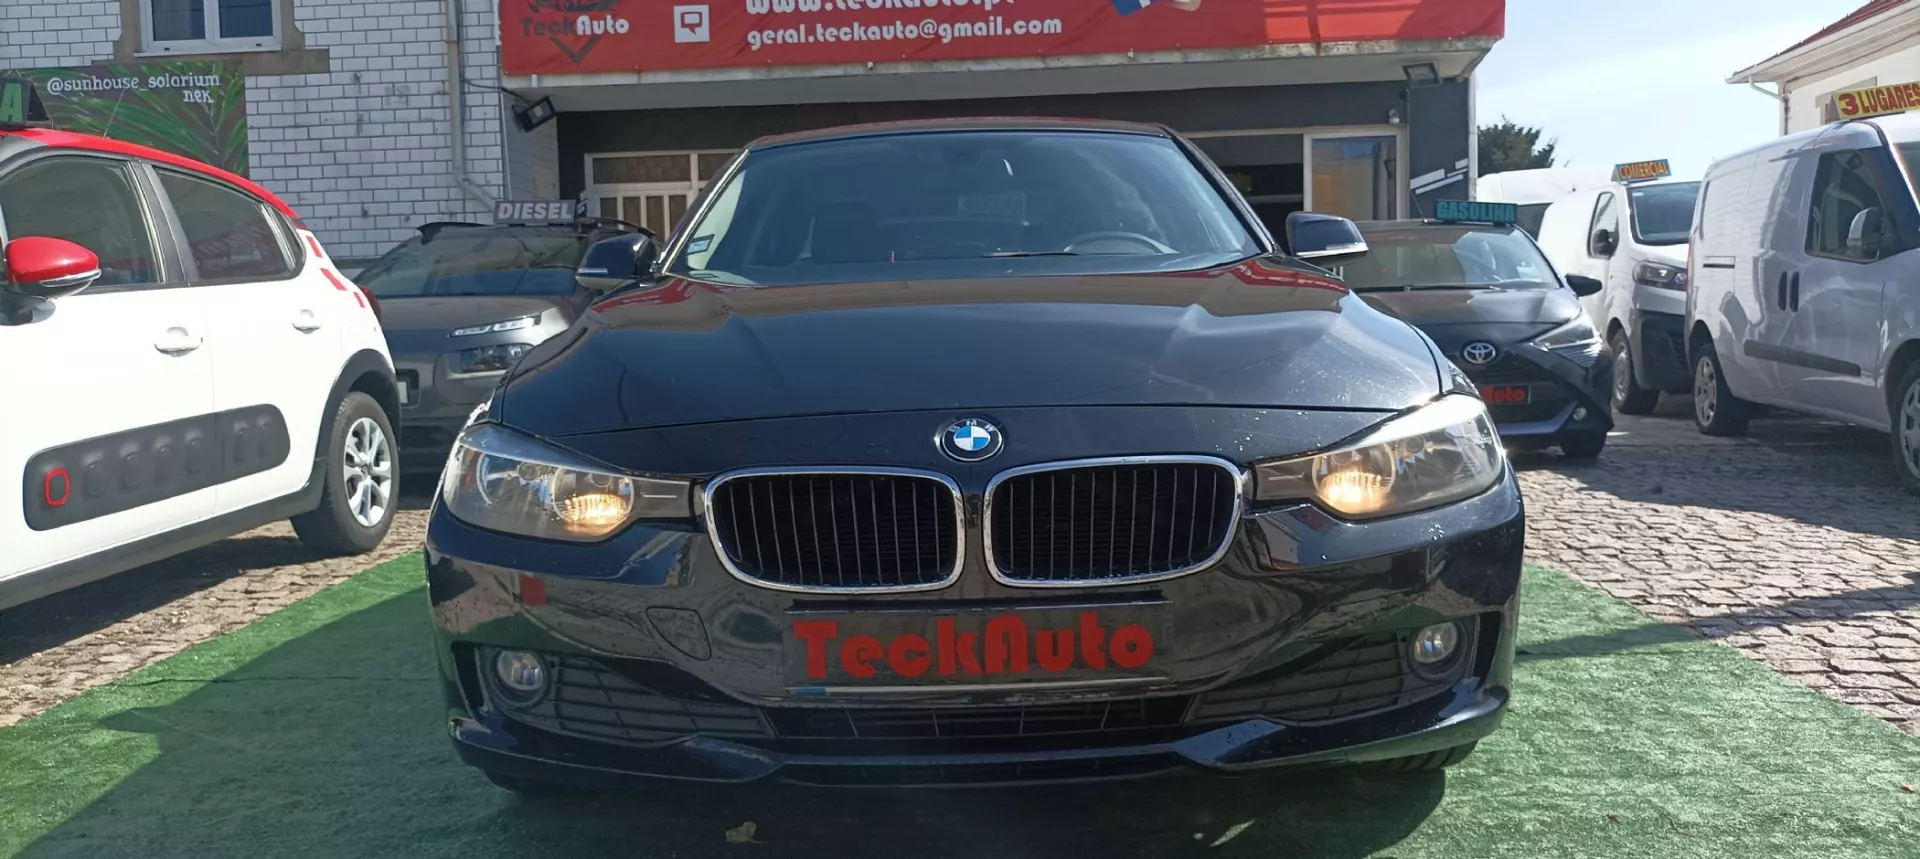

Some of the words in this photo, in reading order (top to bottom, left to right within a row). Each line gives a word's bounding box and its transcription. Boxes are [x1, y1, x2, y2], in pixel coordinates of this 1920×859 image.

[747, 16, 1062, 50] geral.teckauto@gmail.com
[47, 73, 221, 95] @sunhouse_solarium
[1838, 93, 1859, 116] 3
[1857, 83, 1920, 113] LUGARES
[498, 202, 572, 220] DIESEL
[1436, 201, 1516, 221] GASOLINA
[793, 612, 1154, 680] TeckAuto
